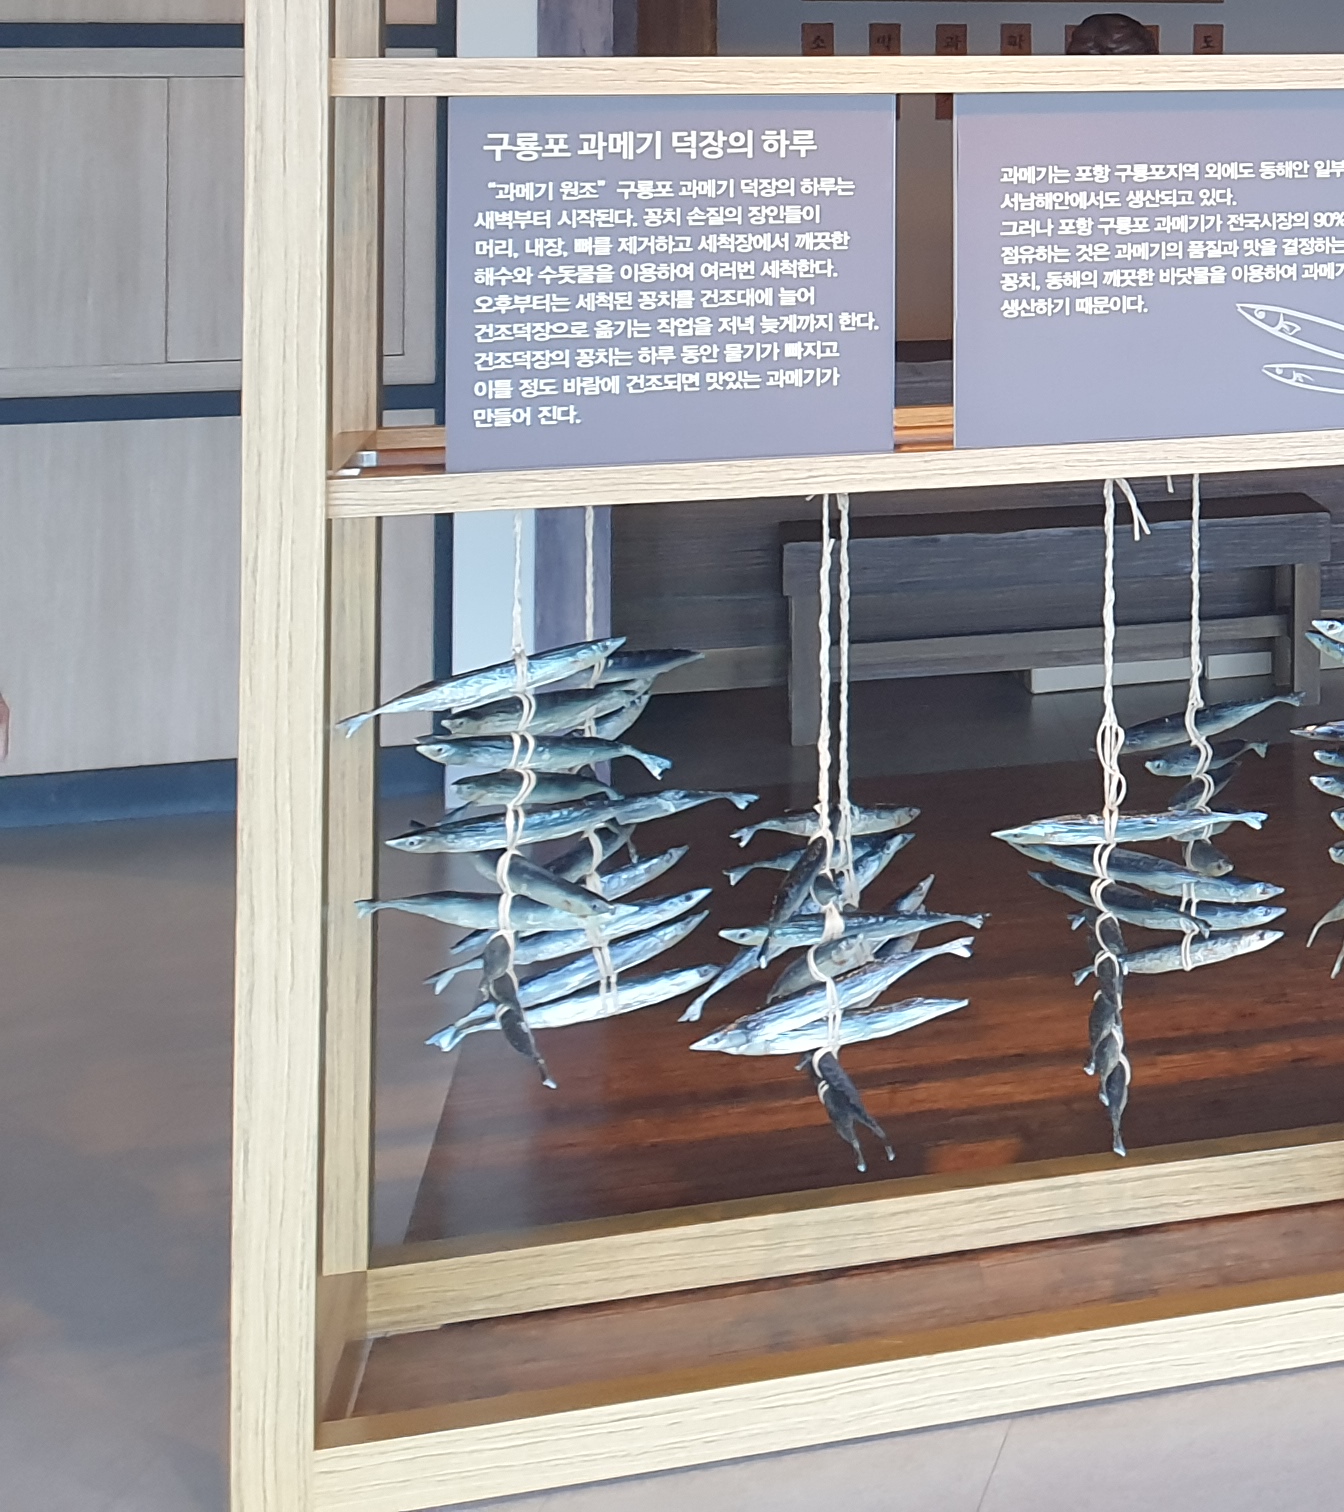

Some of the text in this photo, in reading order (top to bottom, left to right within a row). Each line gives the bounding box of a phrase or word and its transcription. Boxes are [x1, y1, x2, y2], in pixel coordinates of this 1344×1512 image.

[483, 129, 818, 162] 구룡포 과메기 덕장의 하루
[999, 165, 1072, 185] 과메기는
[1074, 164, 1112, 184] 포항
[1114, 162, 1200, 183] 구룡포지역
[1204, 161, 1256, 181] 외에도
[1258, 160, 1310, 180] 동해안
[616, 180, 675, 200] 구룡포
[678, 178, 735, 199] 과메기
[740, 177, 795, 198] 덕장의
[799, 176, 856, 197] 하루는
[1000, 187, 1237, 212] 서남해안에서도 생산되고 있다.
[473, 204, 820, 230] 새벽부터 시작된다. 꽁치 손질의 장인들이
[999, 218, 1055, 238] 그러나
[1057, 216, 1095, 237] 포항
[1097, 216, 1151, 236] 구룡포
[1153, 213, 1224, 234] 과메기가
[1226, 211, 1309, 232] 전국시장의
[475, 230, 851, 259] 머리, 내장, 뼈를 제거하고 세척장에서 깨끗한
[1000, 244, 1072, 265] 점유하는
[1075, 242, 1111, 263] 것은
[1114, 240, 1183, 261] 과메기의
[1186, 238, 1240, 259] 품질과
[1243, 237, 1278, 257] 맛을
[474, 258, 838, 287] 해수와 수돗물을 이용하여 여러번 세척한다.
[999, 271, 1041, 292] 꽁치,
[1044, 269, 1098, 290] 동해의
[1102, 267, 1156, 288] 깨끗한
[1159, 265, 1228, 286] 바닷물을
[1231, 262, 1297, 283] 이용하여
[473, 293, 572, 315] 오후부터는
[575, 291, 633, 312] 세척된
[700, 287, 773, 308] 건조대에
[777, 285, 815, 306] 늘어
[1000, 294, 1149, 318] 생산하기 때문이다.
[474, 311, 880, 343] 건조덕장으로 옮기는 작업을 저녁 늦게까지 한다.
[474, 340, 840, 371] 건조덕장의 꽁치는 하루 동안 물기가 빠지고
[518, 378, 559, 398] 정도
[563, 375, 620, 396] 바람에
[626, 371, 700, 394] 건조되면
[705, 370, 763, 391] 맛있는
[765, 366, 841, 389] 과메기가
[473, 404, 582, 428] 만들어 진다.
